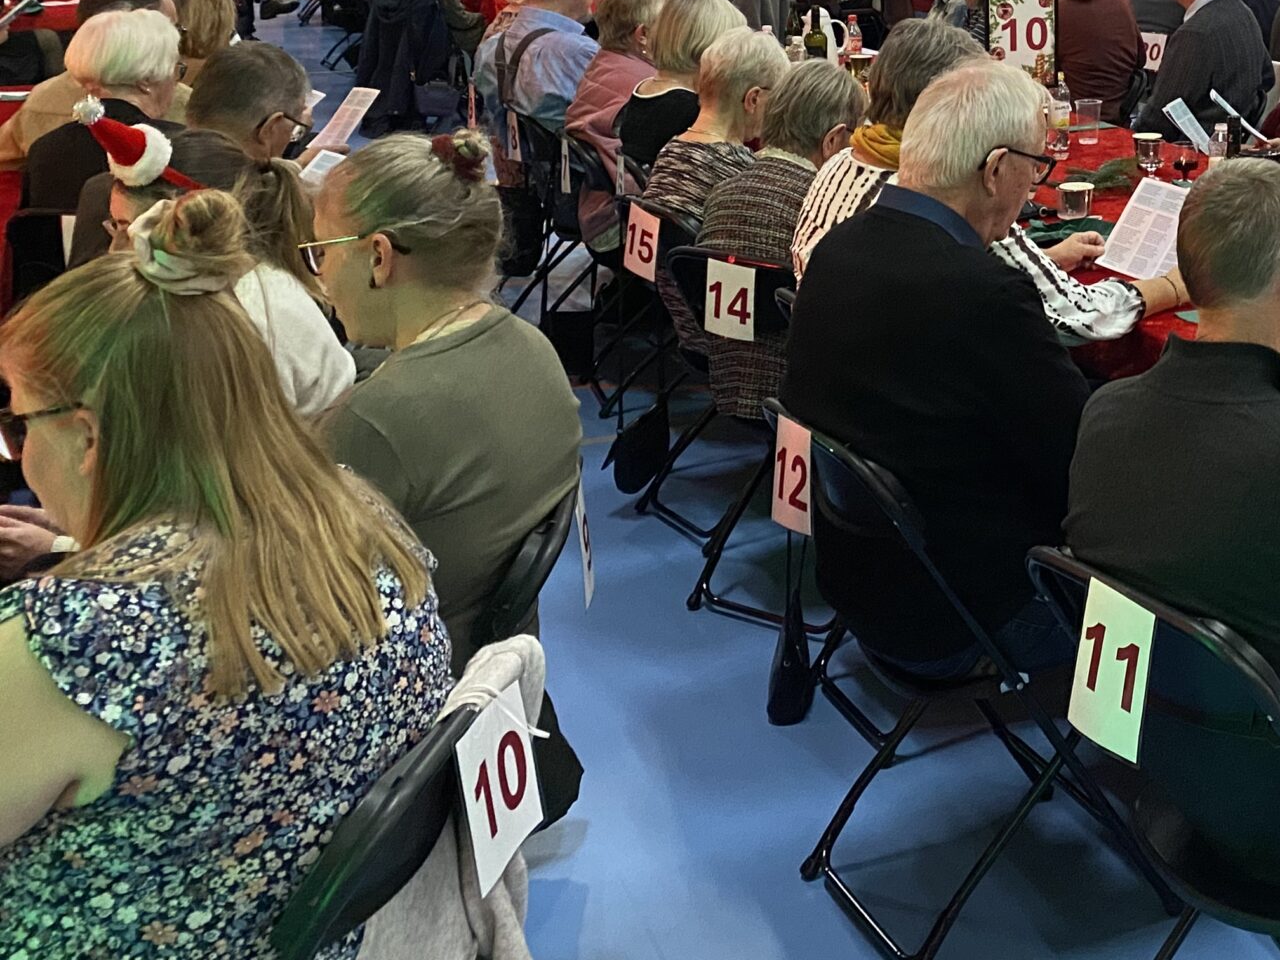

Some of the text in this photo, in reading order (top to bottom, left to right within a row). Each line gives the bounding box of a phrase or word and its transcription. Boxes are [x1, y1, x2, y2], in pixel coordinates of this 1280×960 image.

[1001, 16, 1048, 52] 10
[628, 223, 653, 264] 15
[708, 281, 751, 325] 14
[777, 447, 807, 512] 12
[1085, 622, 1140, 713] 11
[474, 730, 527, 839] 10
